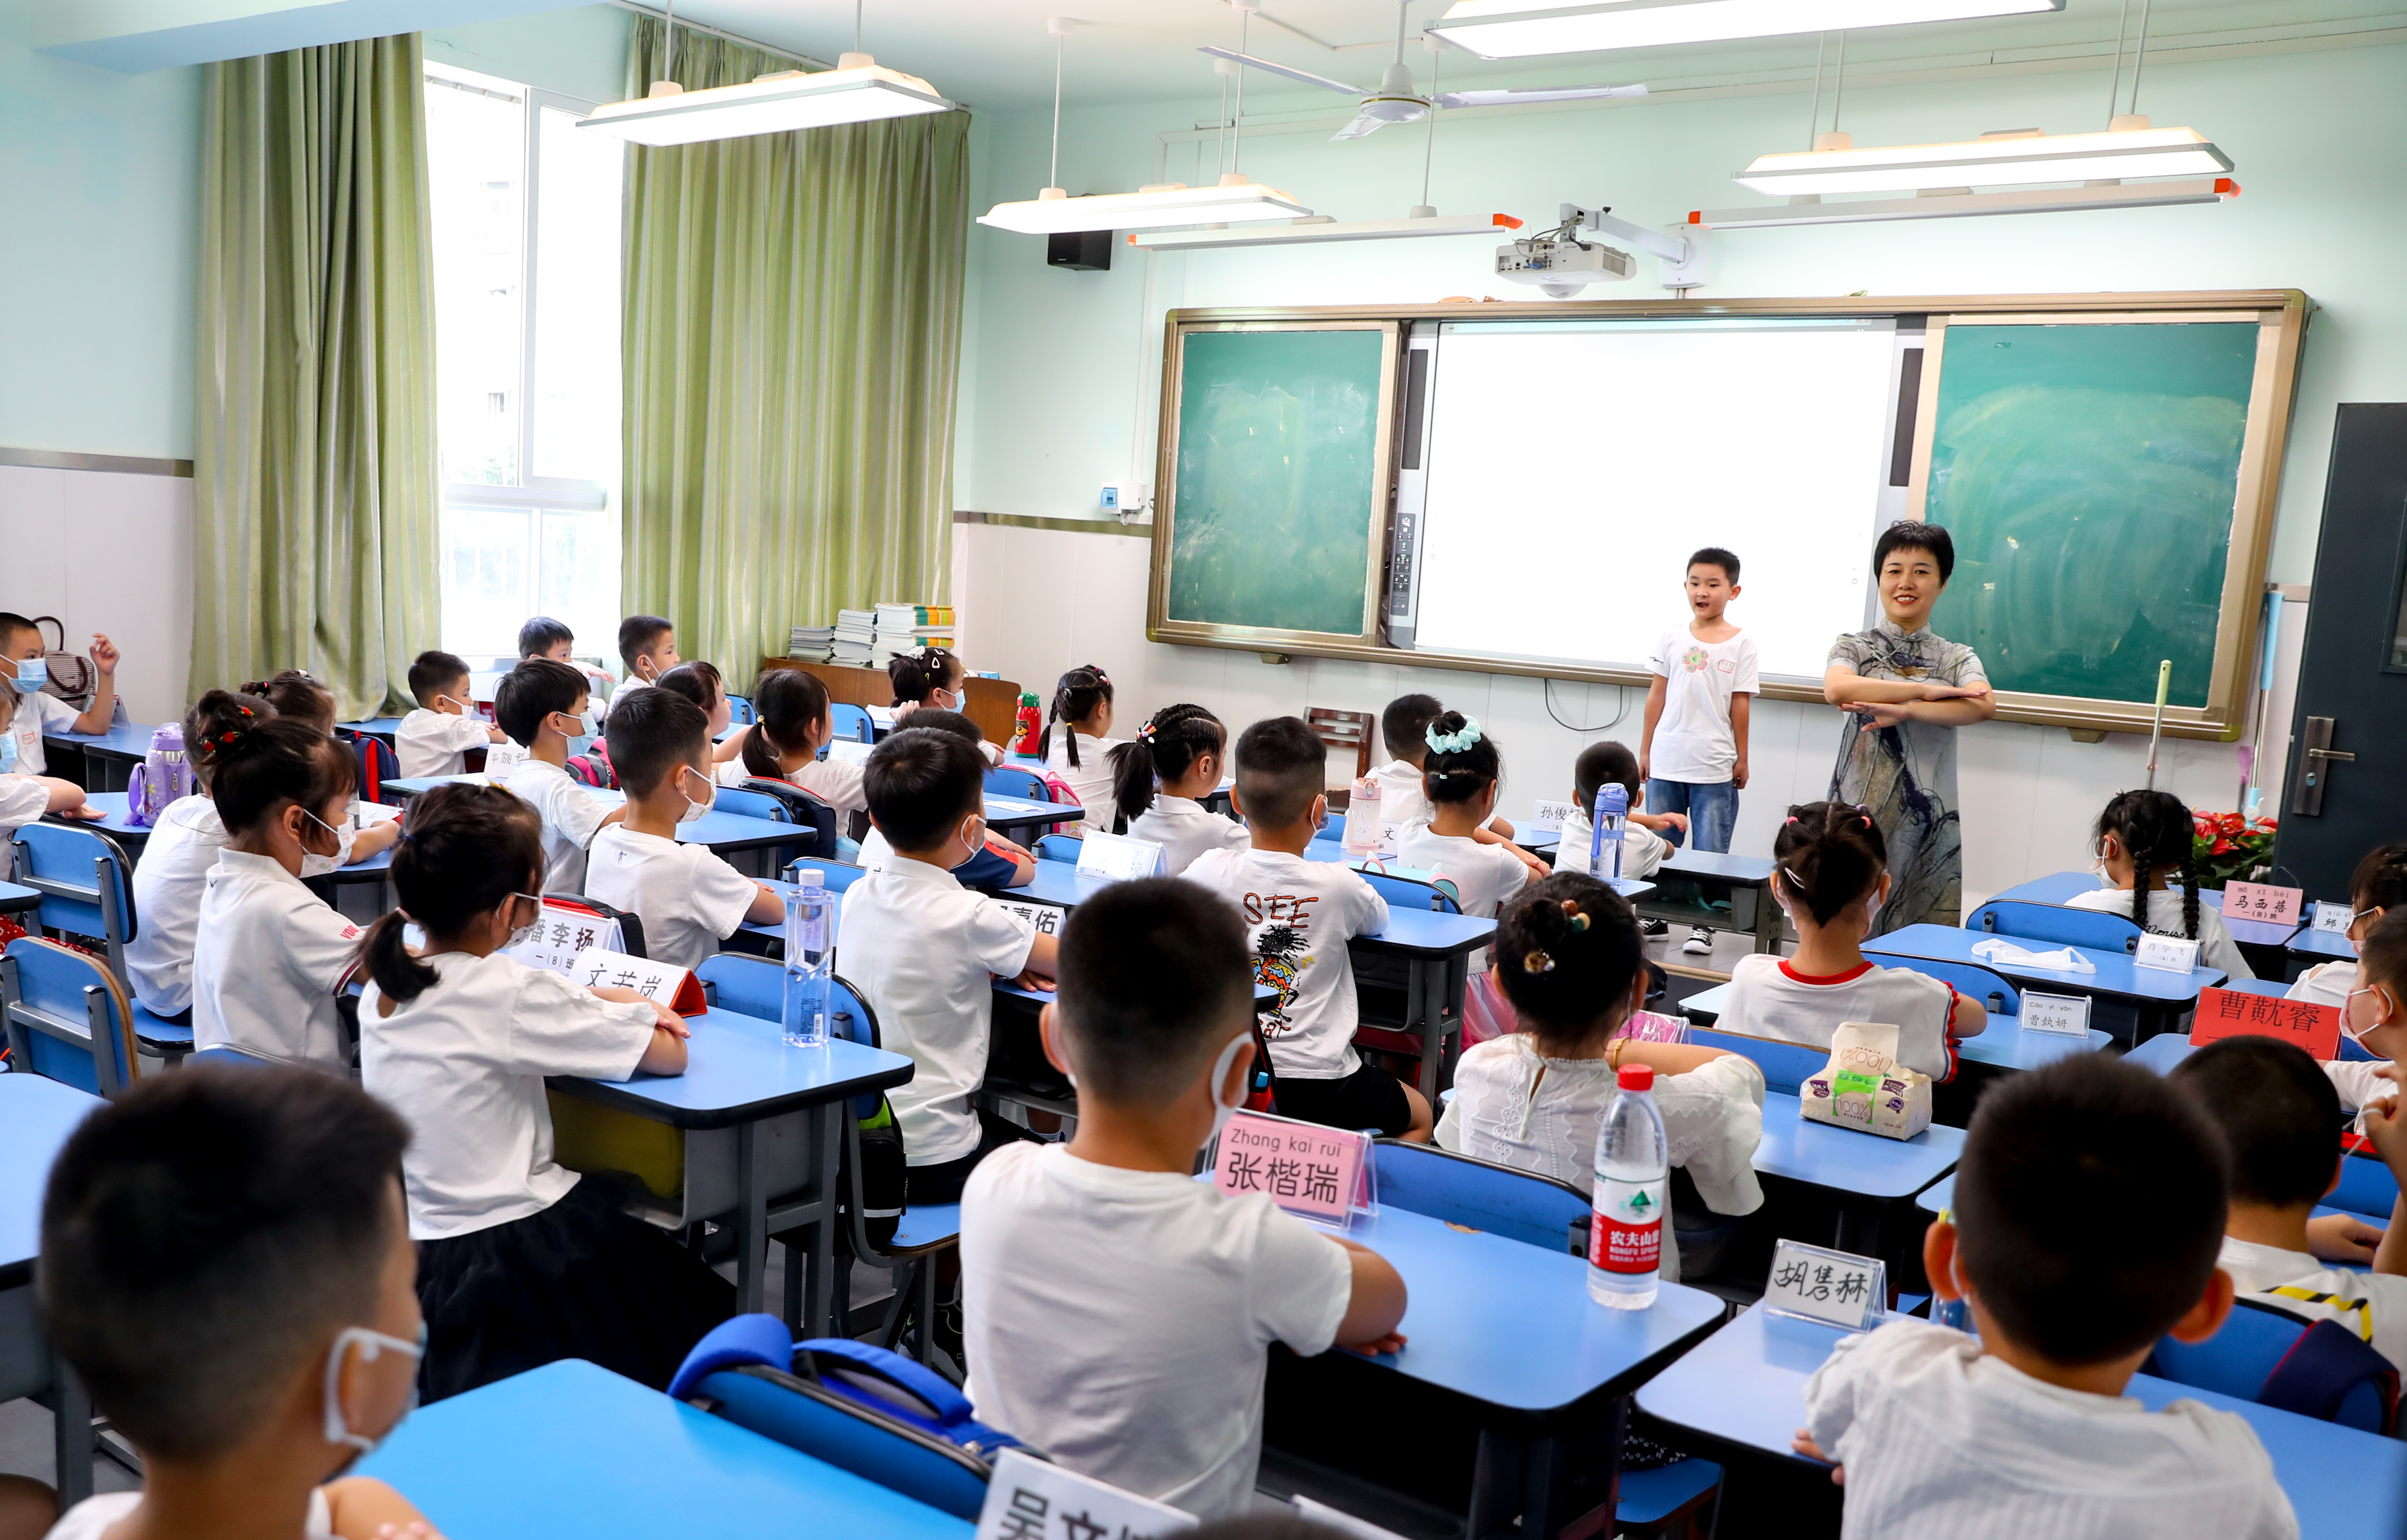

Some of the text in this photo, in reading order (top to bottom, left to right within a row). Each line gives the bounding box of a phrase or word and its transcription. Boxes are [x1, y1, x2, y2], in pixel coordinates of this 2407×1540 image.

[1540, 805, 1580, 822] 孙俊
[1382, 827, 1395, 840] 文
[1243, 892, 1319, 928] SEE
[2235, 895, 2287, 913] 马西蓓
[1838, 1099, 1868, 1116] 100%
[1231, 1129, 1341, 1157] Zhang kai rui
[1226, 1151, 1339, 1204] 张楷瑞
[1774, 1261, 1868, 1303] 胡隽赫
[997, 1486, 1155, 1540] 吴文
